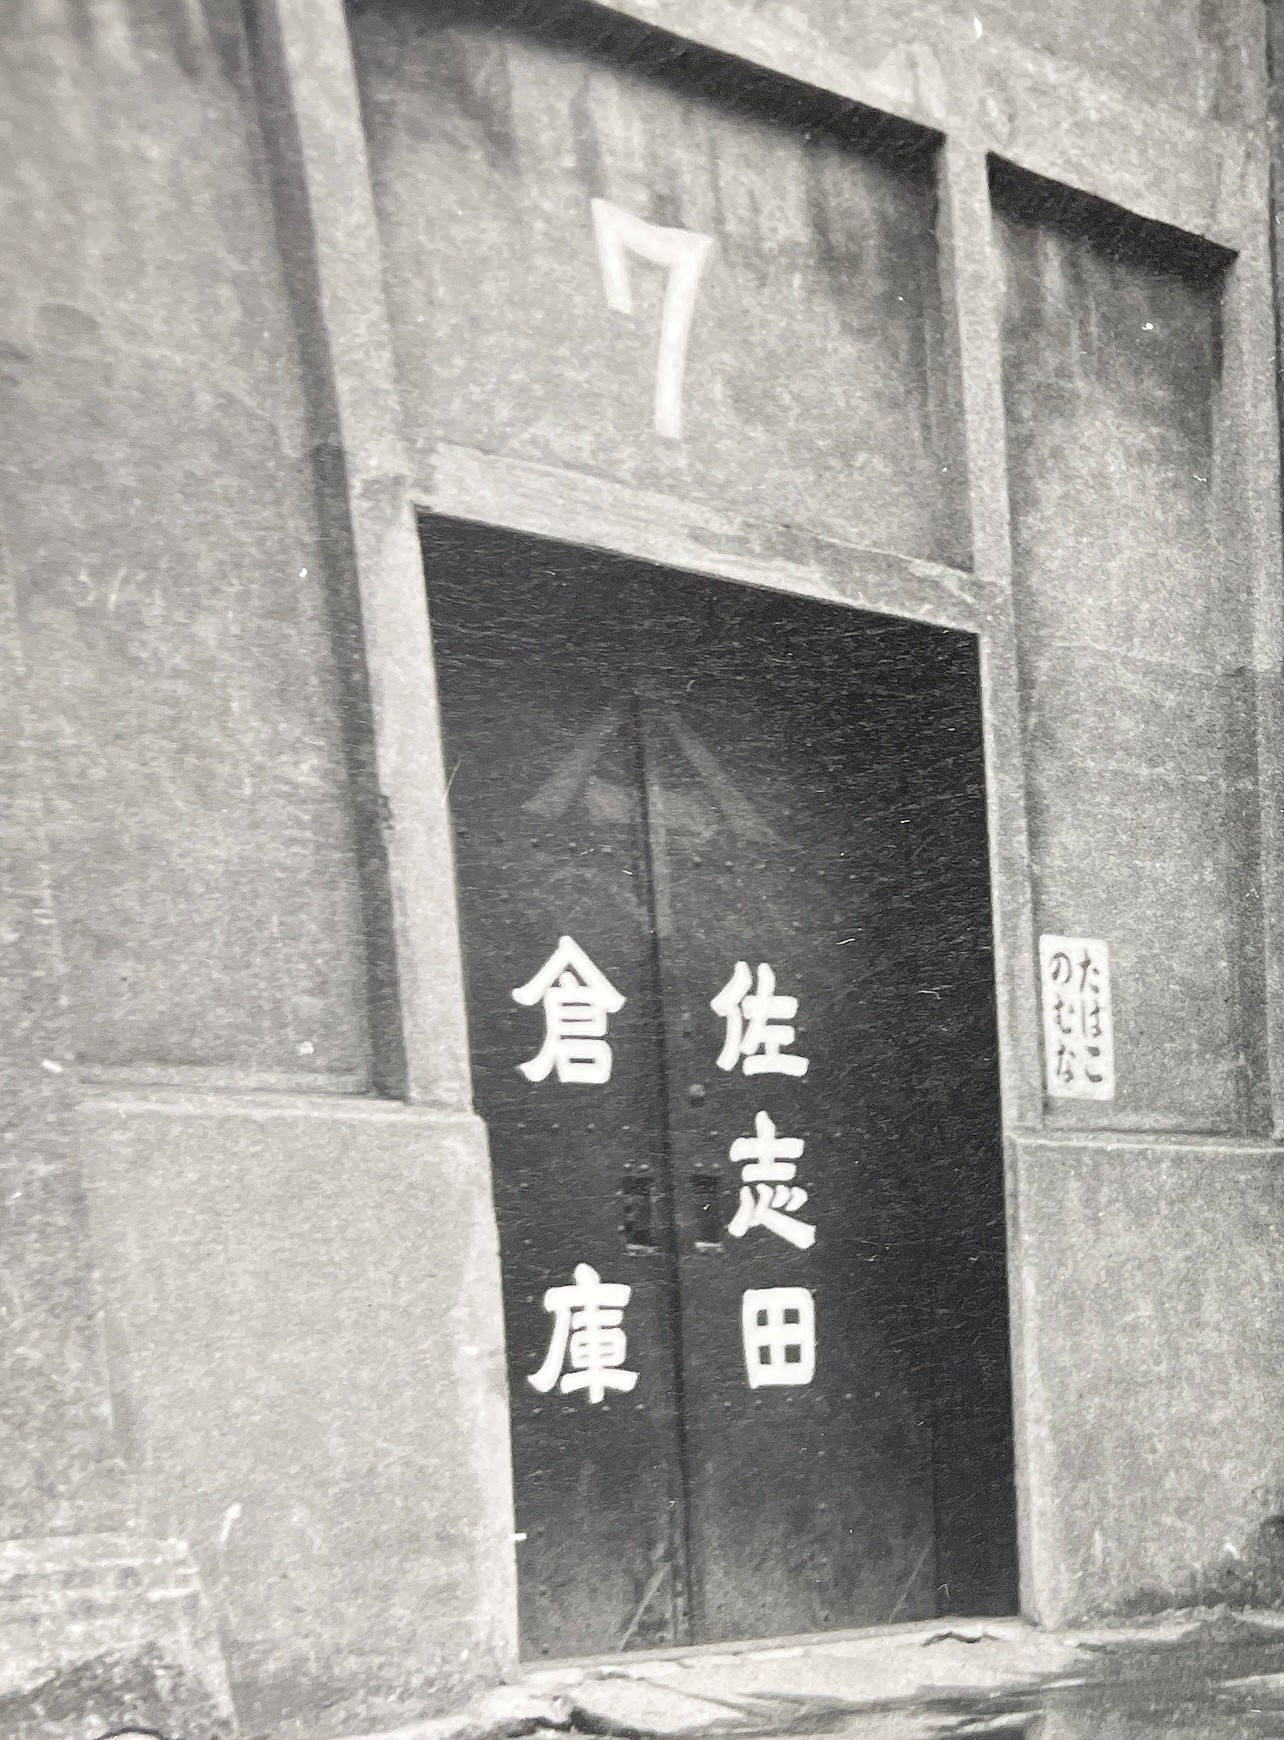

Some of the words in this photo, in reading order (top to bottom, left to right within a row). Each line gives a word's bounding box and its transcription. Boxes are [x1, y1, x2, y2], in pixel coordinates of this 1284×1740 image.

[591, 197, 714, 438] 7
[512, 935, 640, 1404] 倉庫
[711, 961, 817, 1389] 佐志田
